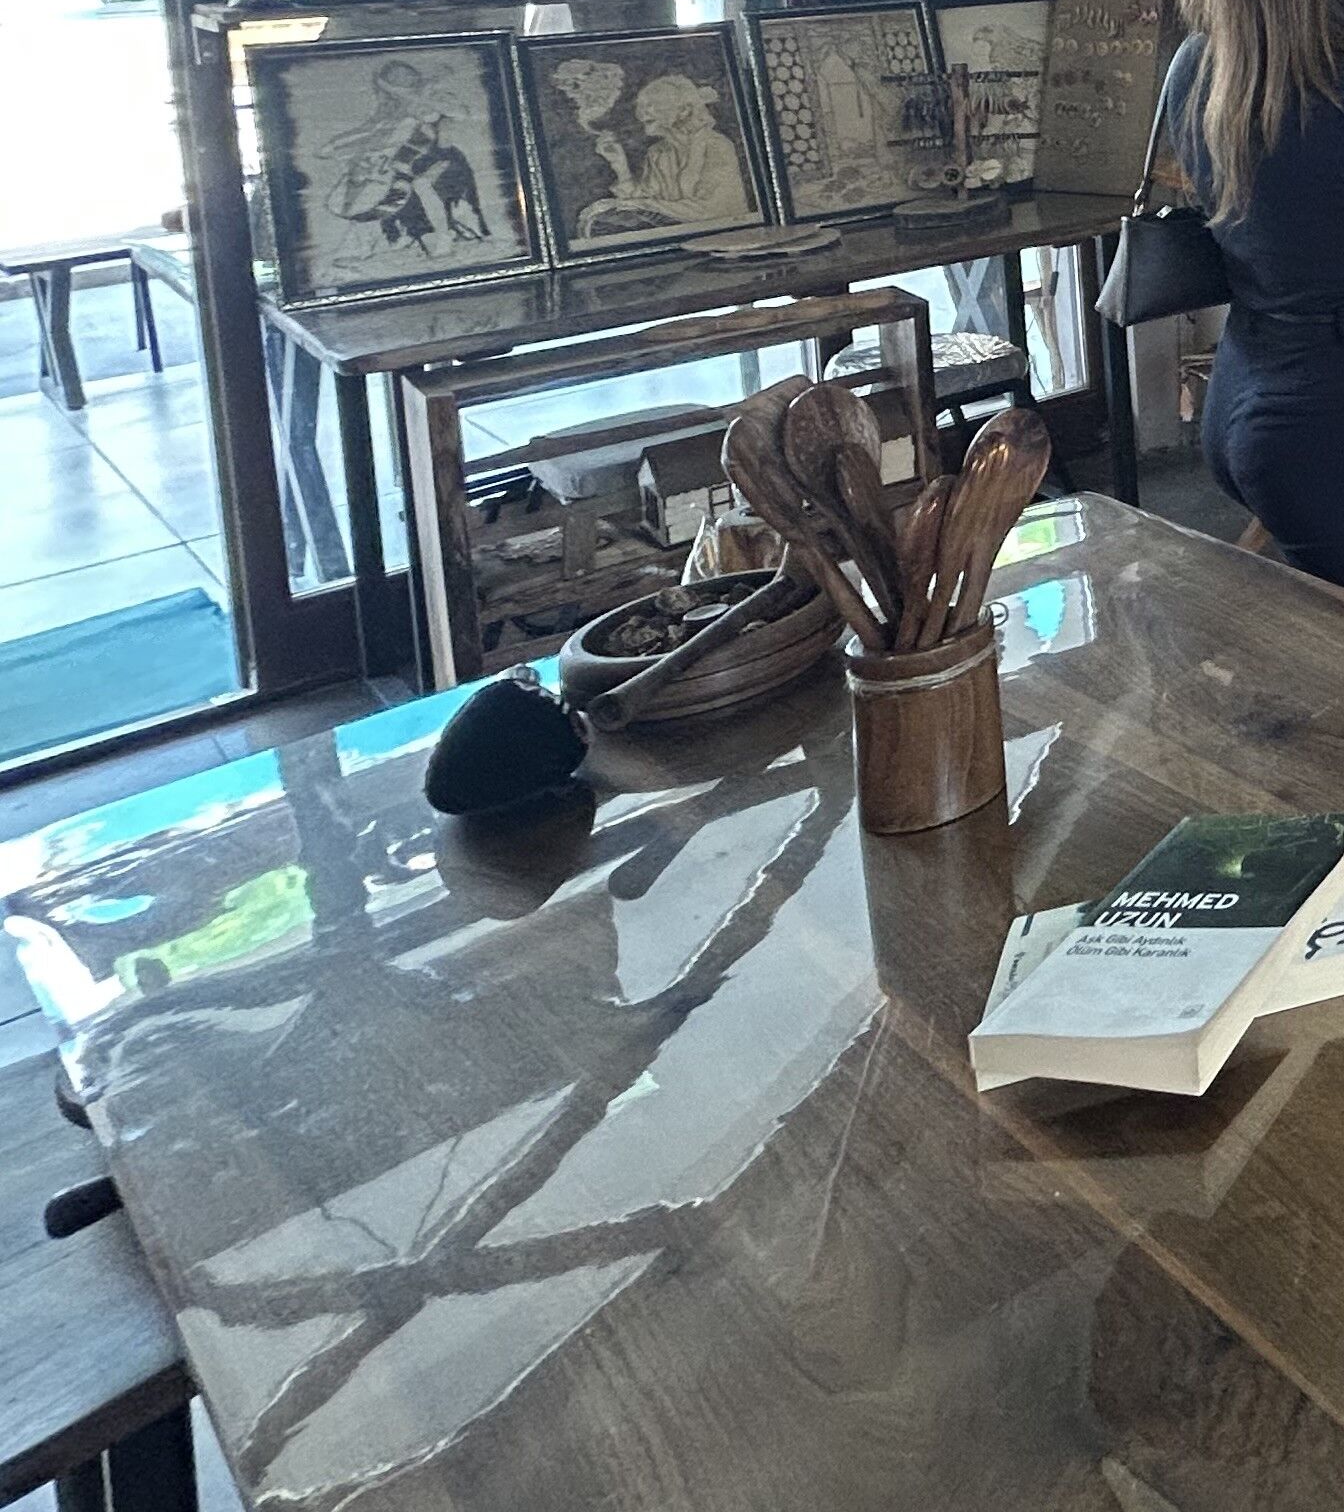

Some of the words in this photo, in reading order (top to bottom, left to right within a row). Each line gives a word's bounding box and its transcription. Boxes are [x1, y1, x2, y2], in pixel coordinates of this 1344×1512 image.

[1111, 891, 1240, 910] MEHMED
[1094, 911, 1182, 928] UZUN
[1105, 934, 1132, 945] Gibi
[1132, 935, 1186, 947] Aydınlık
[1066, 944, 1104, 956] Ölüm
[1105, 945, 1132, 956] Gibi
[1132, 947, 1191, 958] Karanlık
